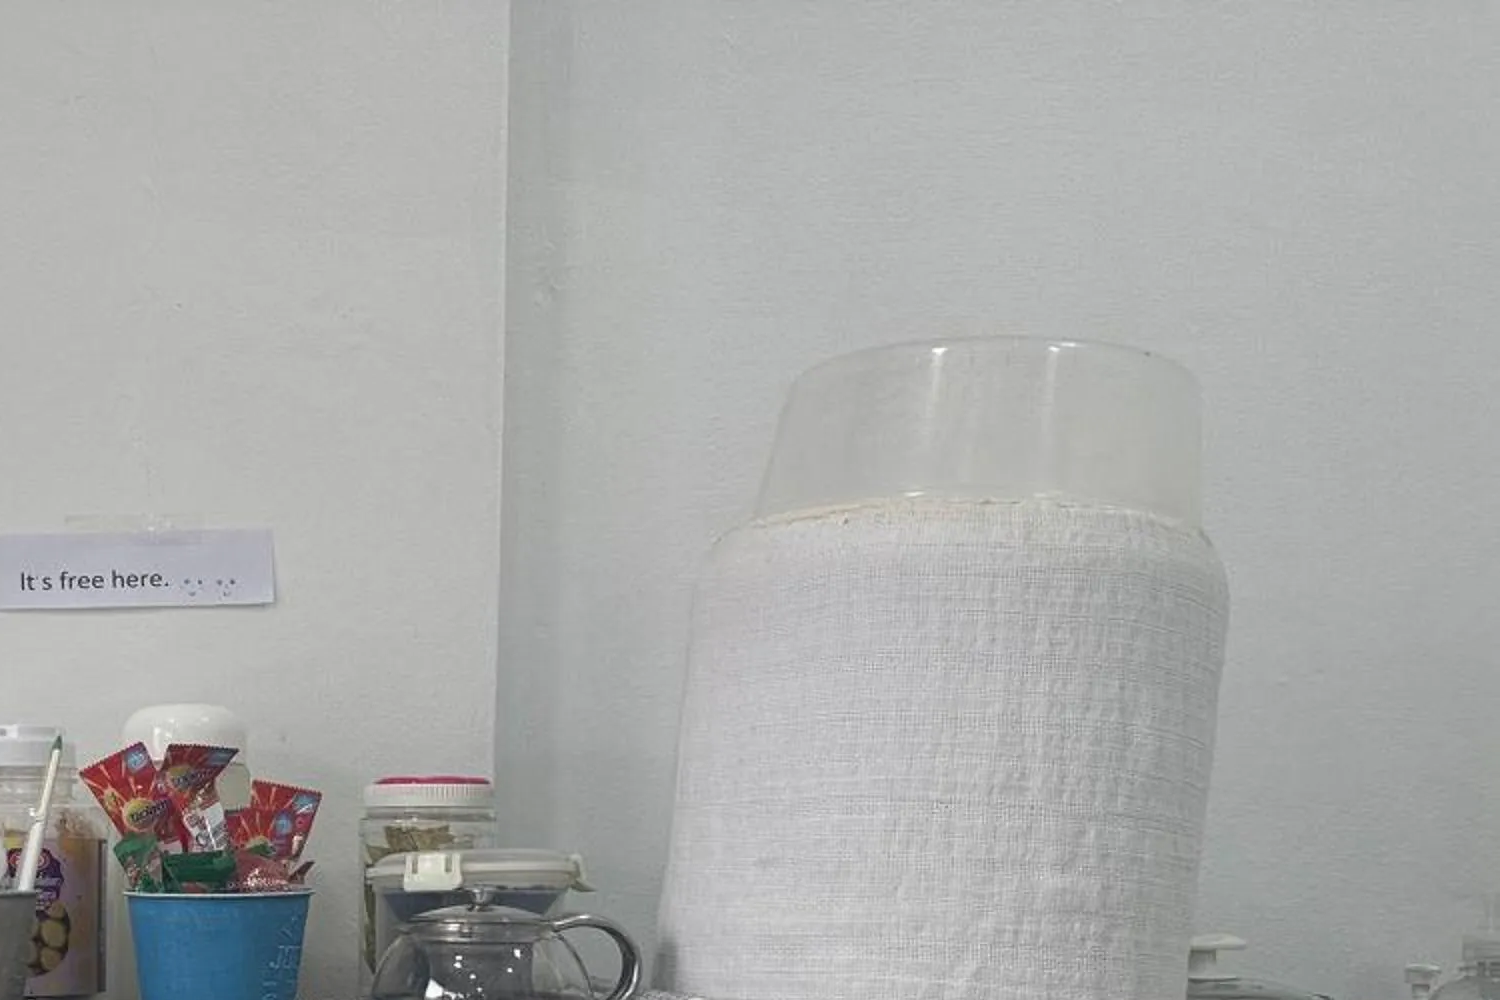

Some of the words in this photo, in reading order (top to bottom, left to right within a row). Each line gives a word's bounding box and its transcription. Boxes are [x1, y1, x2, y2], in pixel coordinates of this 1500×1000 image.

[20, 571, 53, 592] It's
[59, 570, 105, 590] free
[111, 569, 170, 589] here.
